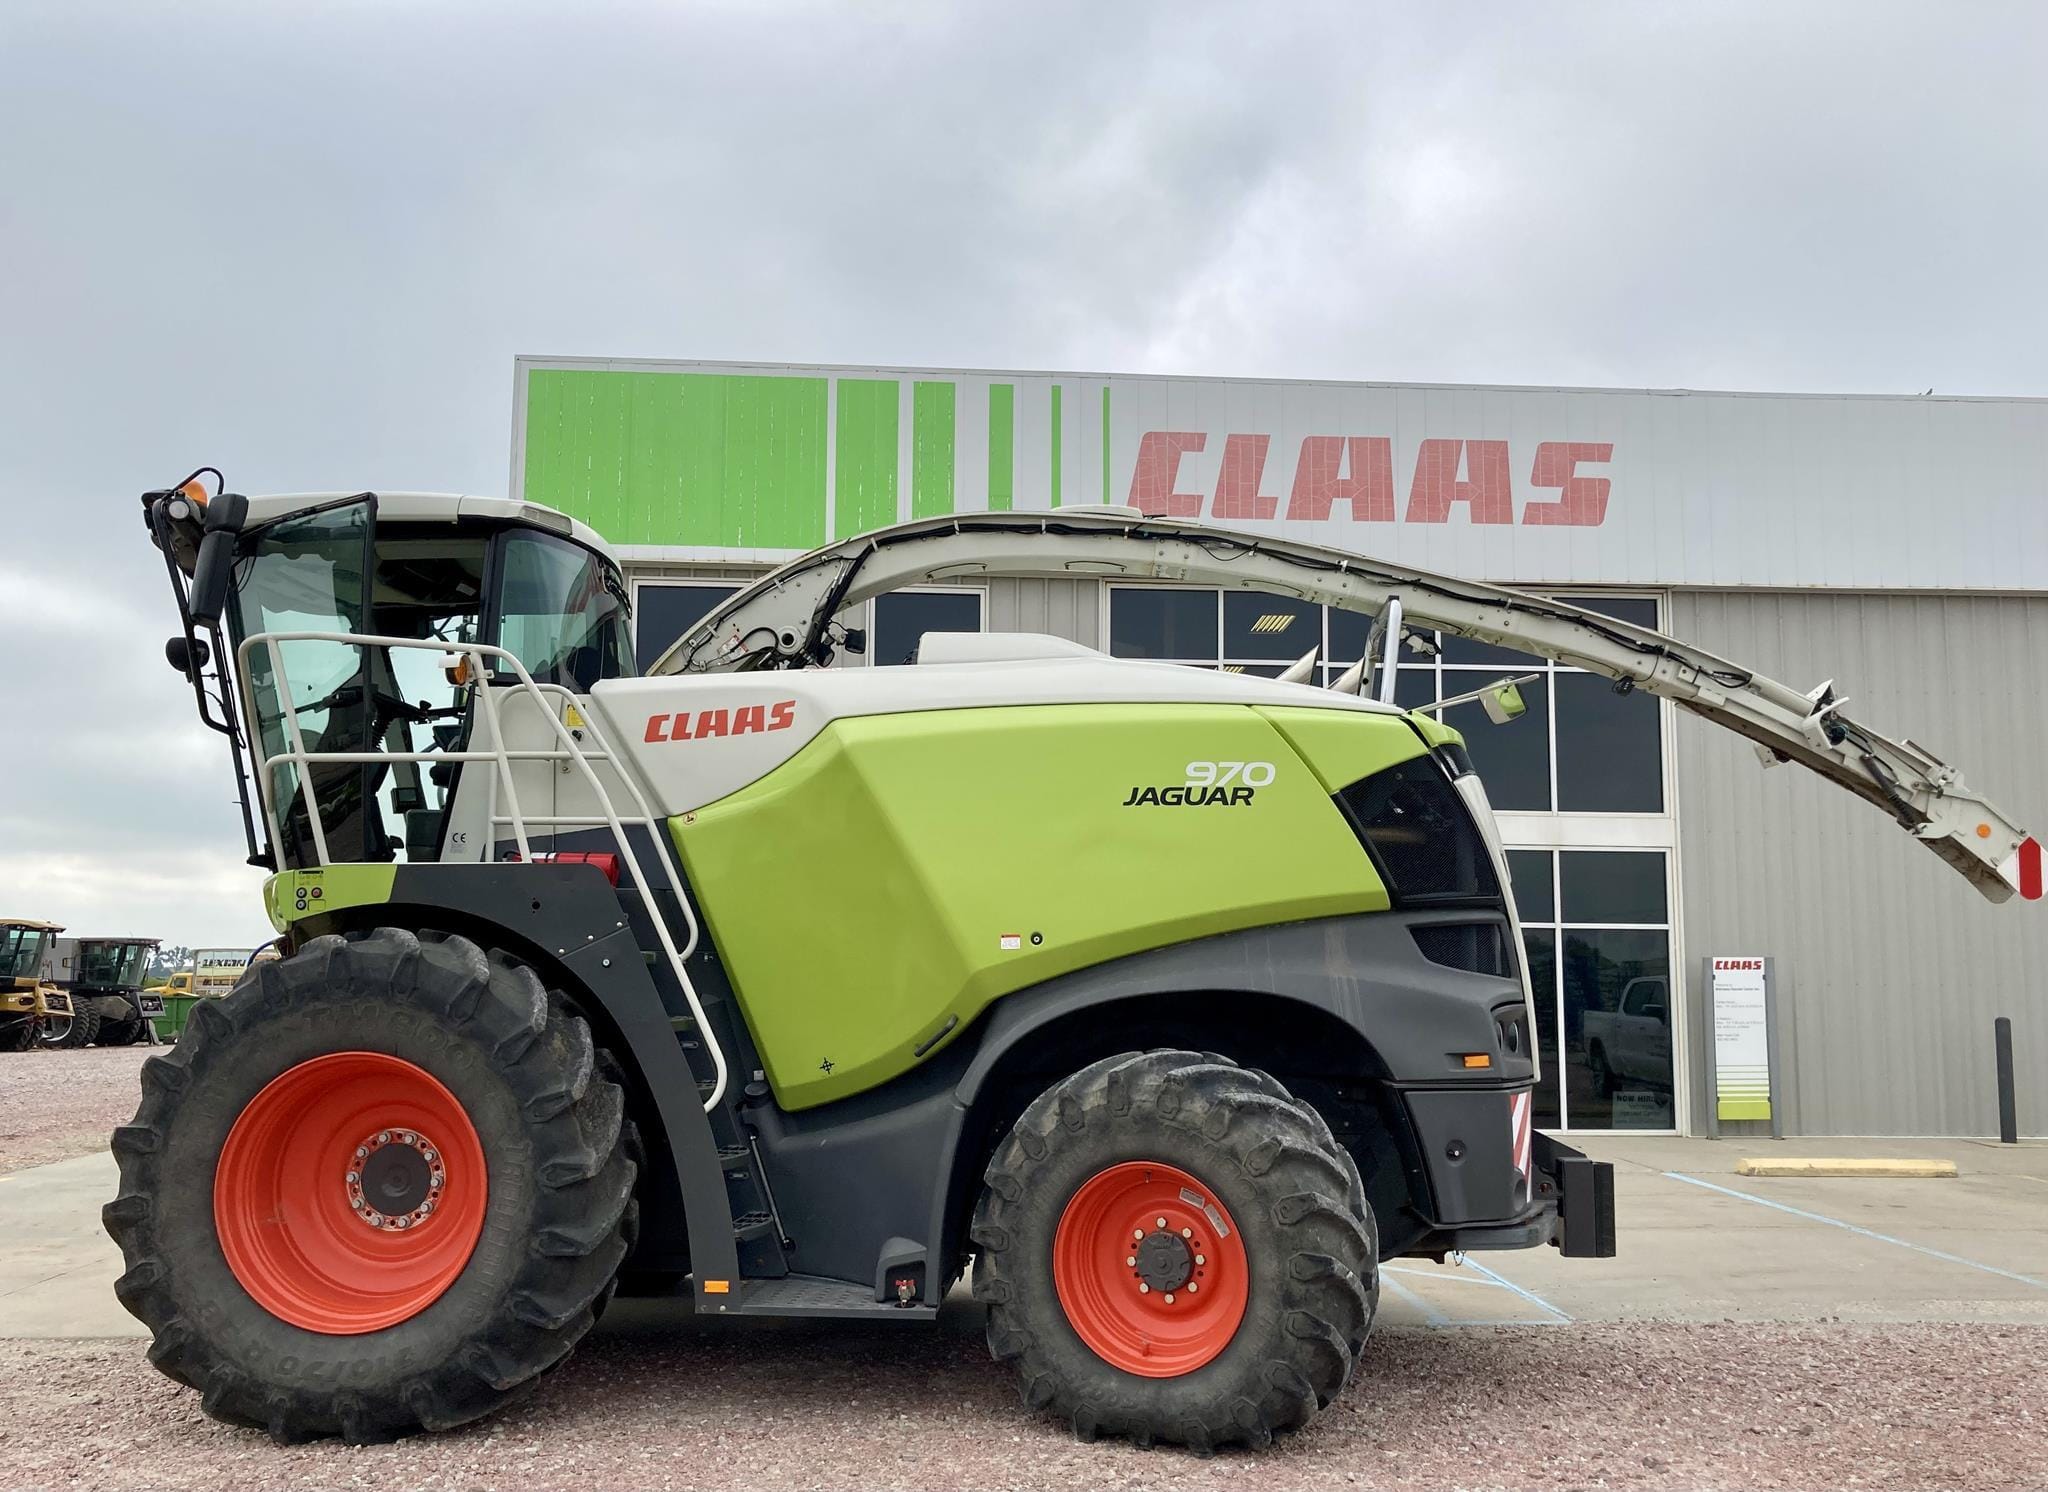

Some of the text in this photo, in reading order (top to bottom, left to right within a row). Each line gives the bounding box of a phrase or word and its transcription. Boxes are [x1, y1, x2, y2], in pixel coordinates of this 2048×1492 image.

[1126, 431, 1614, 527] CLAAS
[644, 699, 796, 744] CLAAS
[1185, 761, 1276, 787] 970
[1122, 787, 1255, 806] JAGUAR
[1715, 960, 1762, 970] CLAAS
[1616, 1095, 1635, 1103] NOW
